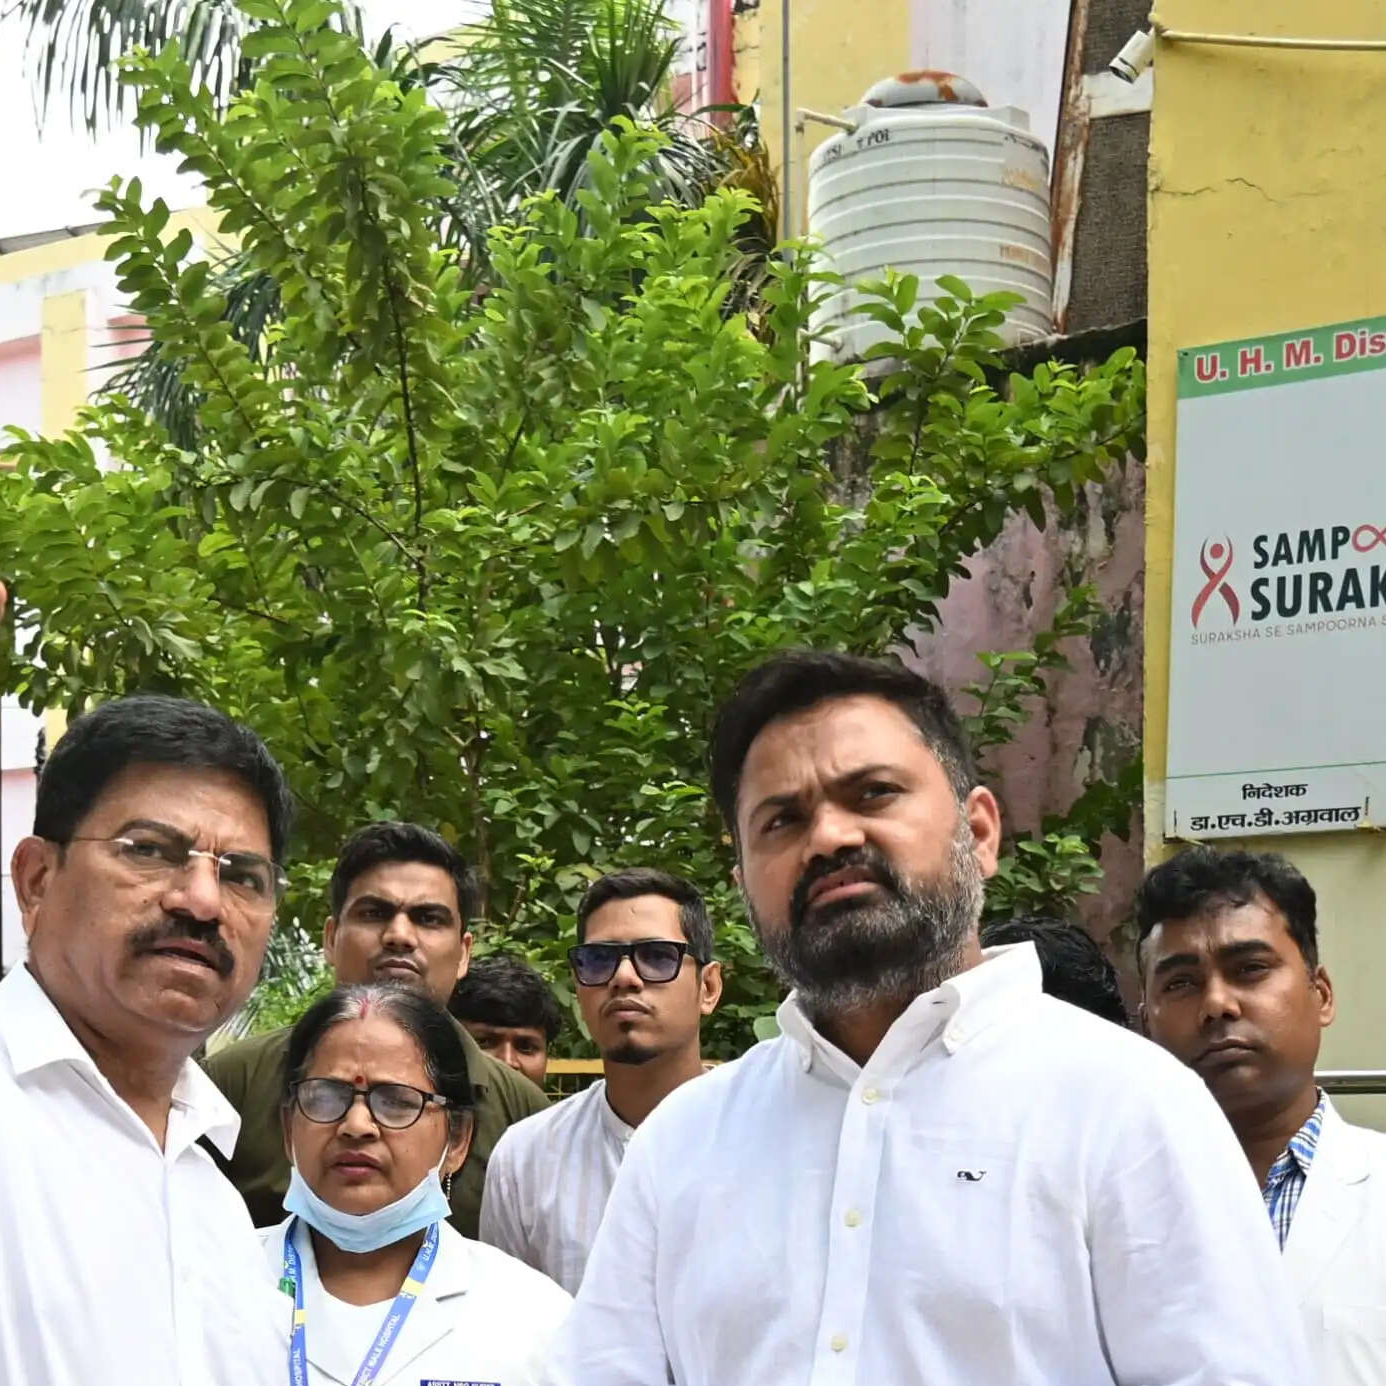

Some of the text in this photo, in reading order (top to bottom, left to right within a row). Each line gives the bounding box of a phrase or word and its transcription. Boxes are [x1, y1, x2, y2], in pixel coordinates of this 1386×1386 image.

[1195, 354, 1228, 382] U.
[1238, 346, 1273, 377] H.
[1284, 339, 1322, 370] M.
[1191, 628, 1261, 646] SURAKSHA
[1265, 625, 1283, 639] SE
[1286, 616, 1377, 637] SAMPOORNA
[1242, 782, 1309, 800] निदेशक
[293, 1348, 303, 1386] HOSPITAL
